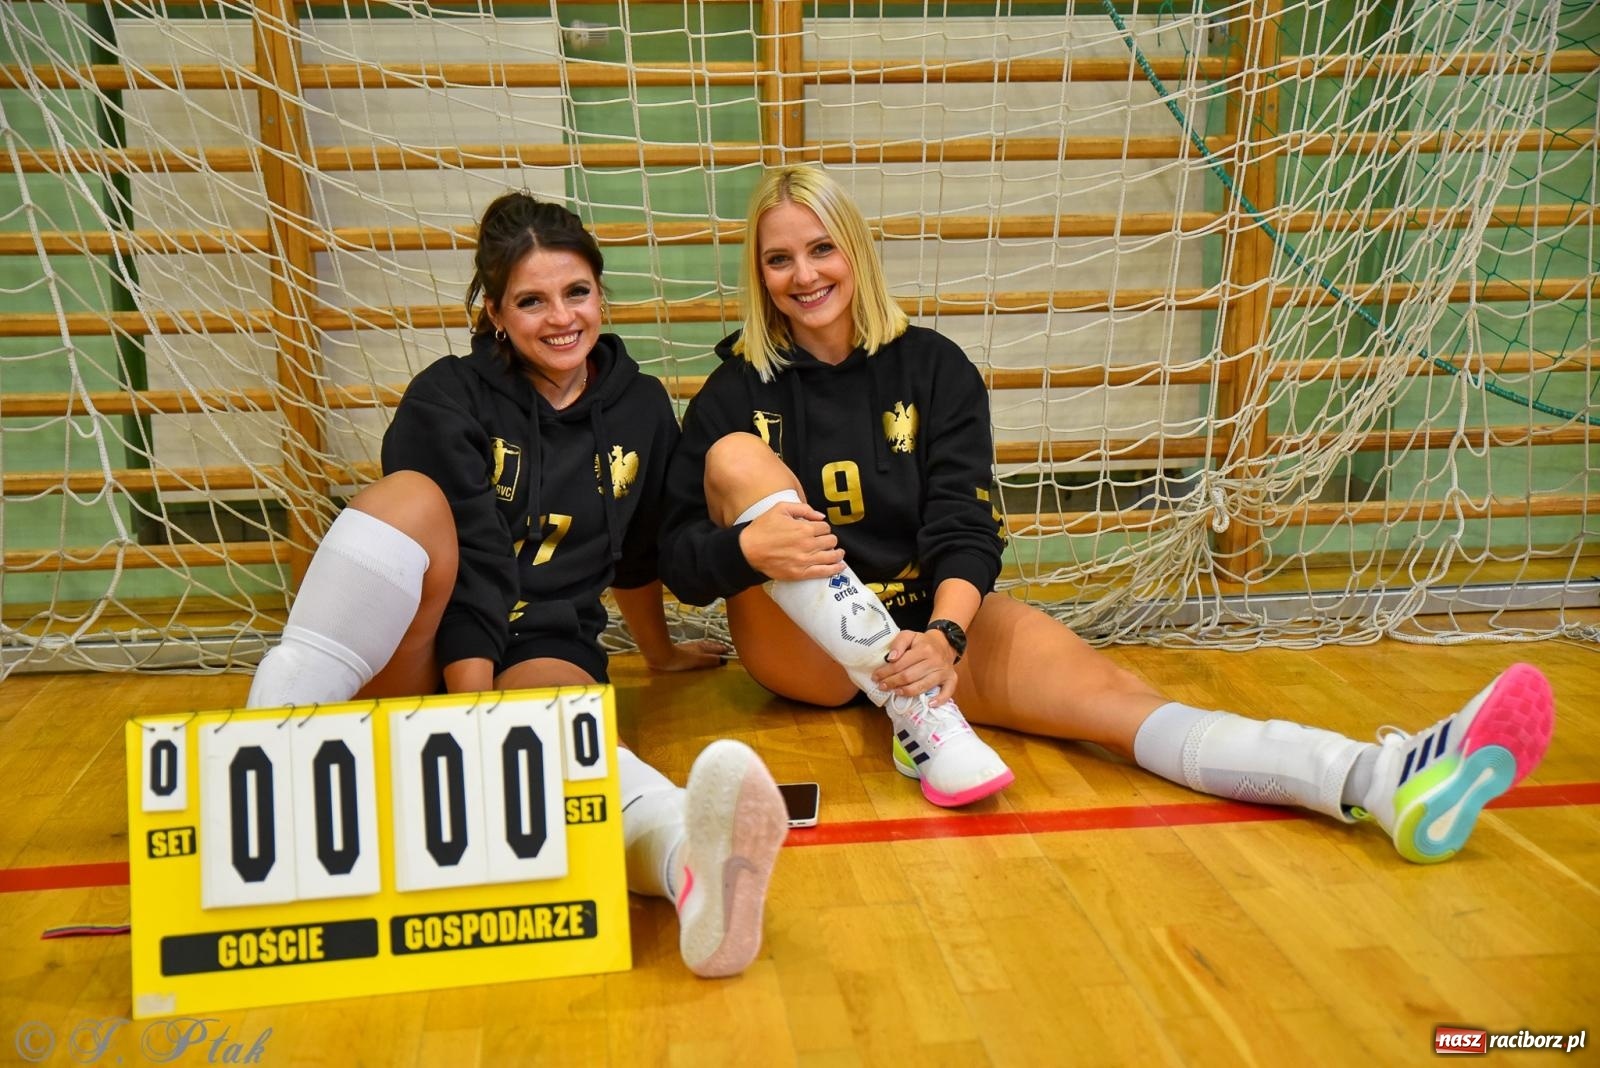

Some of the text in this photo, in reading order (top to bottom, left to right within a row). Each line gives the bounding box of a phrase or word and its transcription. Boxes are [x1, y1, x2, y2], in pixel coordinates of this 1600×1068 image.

[821, 460, 865, 526] 9
[572, 712, 600, 767] 0
[149, 739, 178, 796] 0
[566, 797, 604, 824] SET
[150, 829, 192, 857] SET
[218, 926, 324, 968] GOŚCIE
[404, 905, 584, 951] GOSPODARZE
